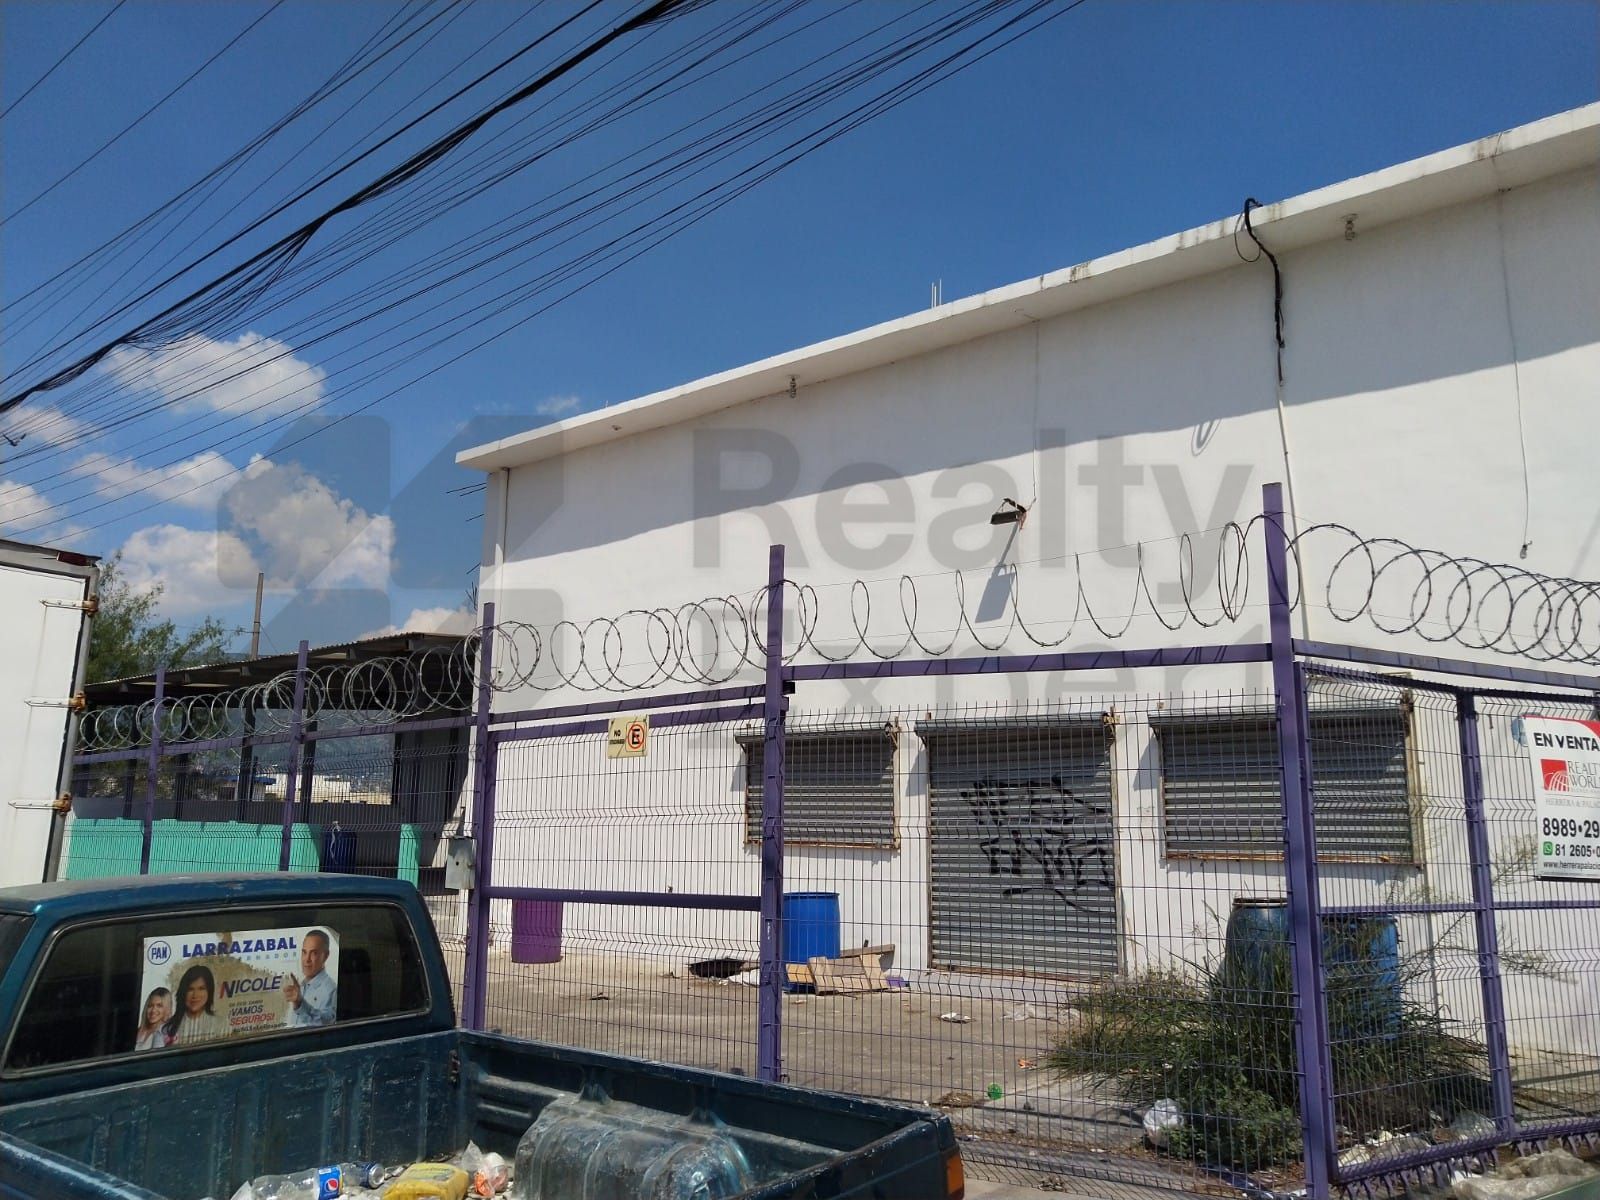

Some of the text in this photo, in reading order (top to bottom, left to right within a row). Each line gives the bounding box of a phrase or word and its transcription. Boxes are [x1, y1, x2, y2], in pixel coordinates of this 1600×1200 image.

[1534, 732, 1600, 751] EN VENTA
[1567, 773, 1600, 788] WORL
[1555, 843, 1566, 856] 81
[151, 945, 168, 959] PAN
[182, 937, 297, 958] LARRAZABAL
[219, 974, 282, 999] NICOLE
